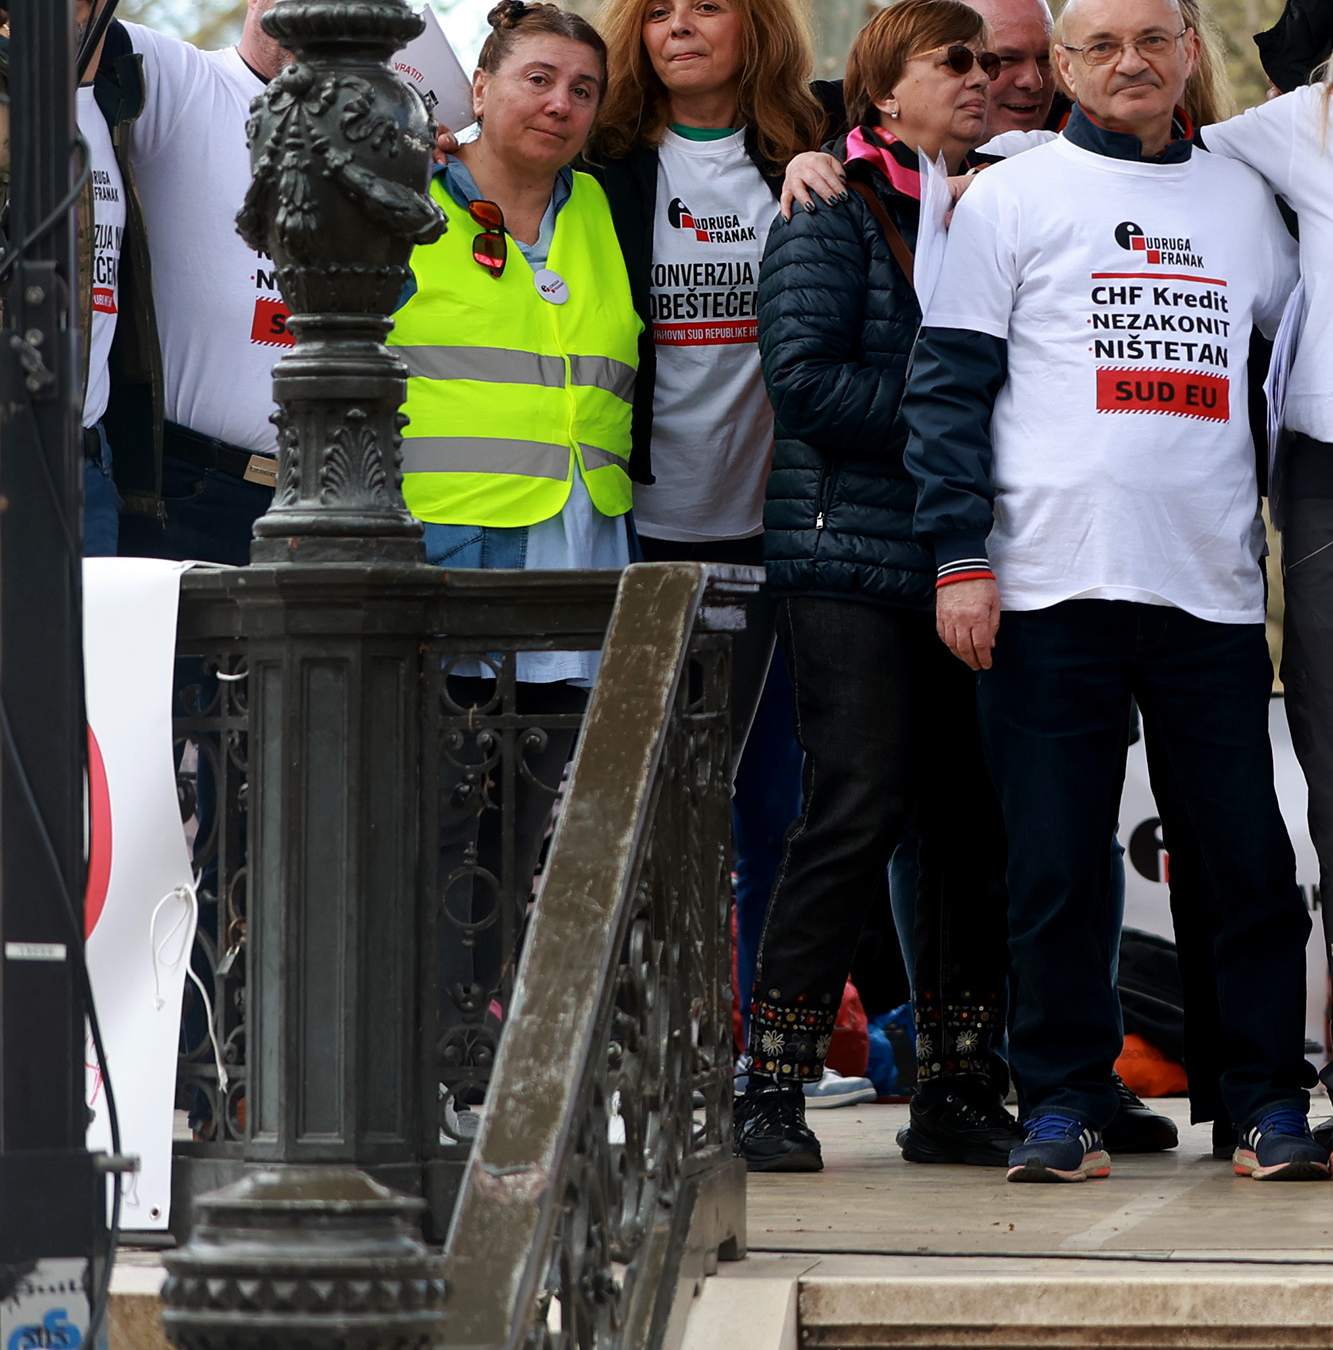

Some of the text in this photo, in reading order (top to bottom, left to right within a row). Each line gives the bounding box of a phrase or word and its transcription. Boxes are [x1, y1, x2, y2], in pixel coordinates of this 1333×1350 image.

[92, 169, 111, 186] RUGA
[694, 214, 741, 231] UDRUGA
[708, 227, 757, 243] FRANAK
[1146, 237, 1192, 252] UDRUGA
[1161, 251, 1205, 269] FRANAK
[1091, 286, 1229, 314] CHF Kredit
[688, 329, 704, 340] SUD
[705, 326, 748, 339] REPUBLIKE
[1092, 313, 1230, 338] NEZAKONIT
[1094, 333, 1228, 368] NIŠTETAN
[1115, 380, 1217, 409] SUD EU
